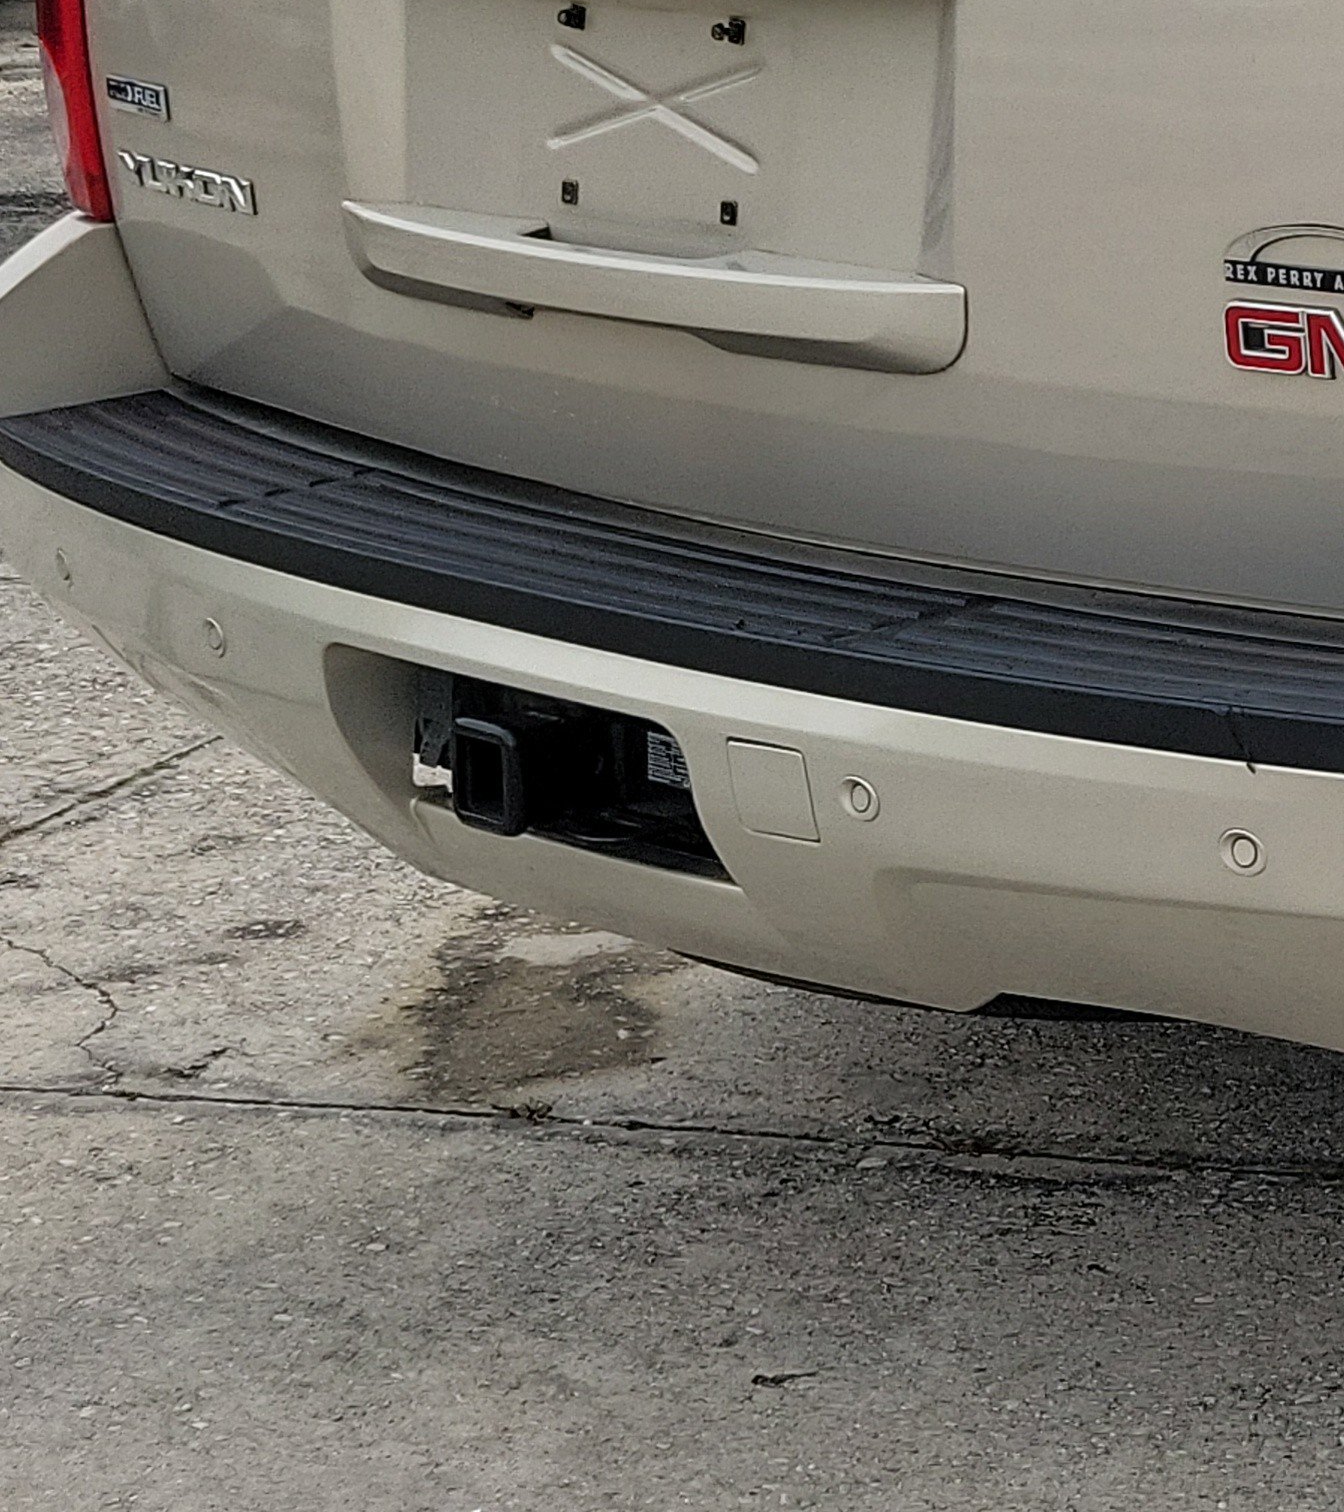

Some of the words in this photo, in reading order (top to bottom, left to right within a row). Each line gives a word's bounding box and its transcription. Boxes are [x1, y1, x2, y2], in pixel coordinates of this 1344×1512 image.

[117, 149, 258, 215] YUKON
[1224, 262, 1258, 282] REX
[1266, 266, 1325, 288] PERRY
